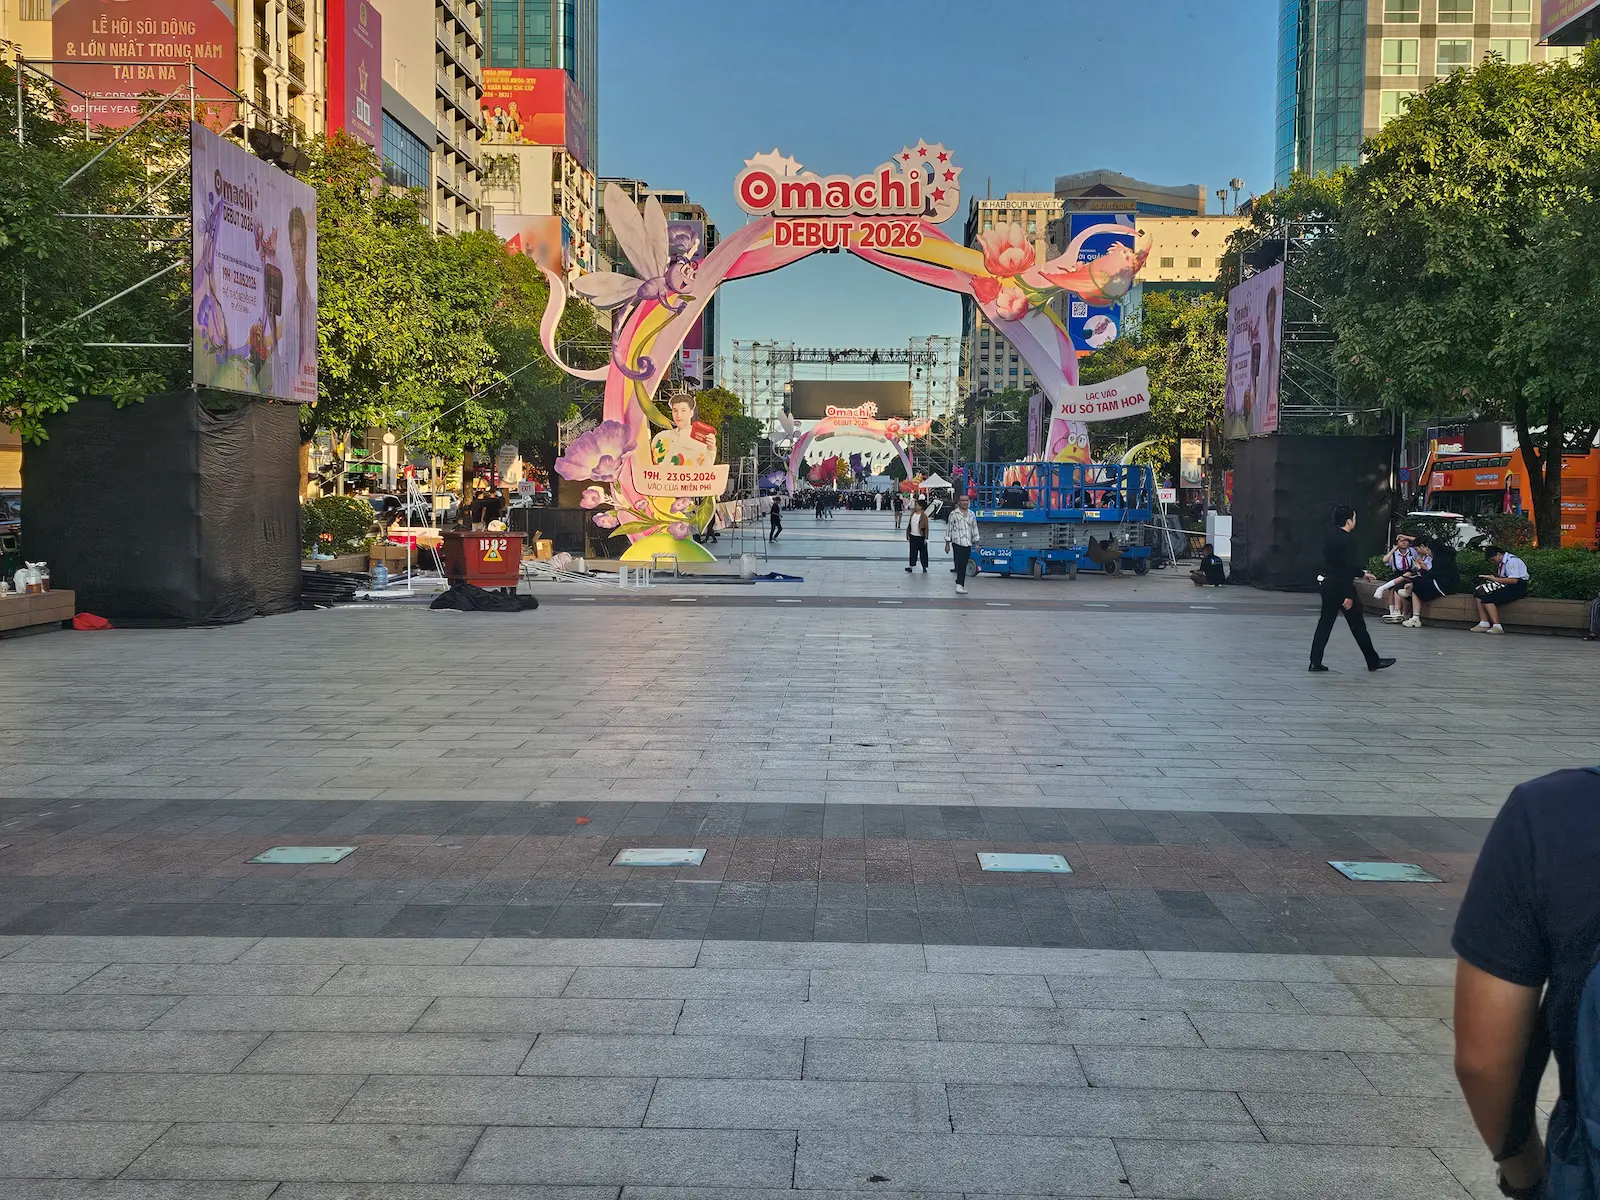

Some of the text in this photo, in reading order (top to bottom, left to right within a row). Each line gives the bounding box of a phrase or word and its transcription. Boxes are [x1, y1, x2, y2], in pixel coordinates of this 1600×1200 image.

[92, 14, 196, 39] LỄ HỘI SÔI ĐỘNG
[66, 38, 223, 58] & LỚN NHẤT TRONG NĂM
[113, 65, 133, 83] TẠI
[70, 104, 137, 114] OF THE YEAR
[214, 168, 253, 213] Omachi
[741, 168, 921, 209] Omachi
[989, 201, 1028, 209] HARBOUR
[1030, 201, 1050, 209] VIEW
[774, 221, 922, 248] DEBUT 2026
[1061, 402, 1078, 414] XỨ
[1096, 400, 1119, 413] TAM
[1121, 393, 1145, 408] HOA
[1085, 388, 1118, 402] LẠC VÀO
[827, 407, 869, 417] Omachi
[666, 471, 717, 482] 23.05.2026
[480, 539, 508, 551] B92
